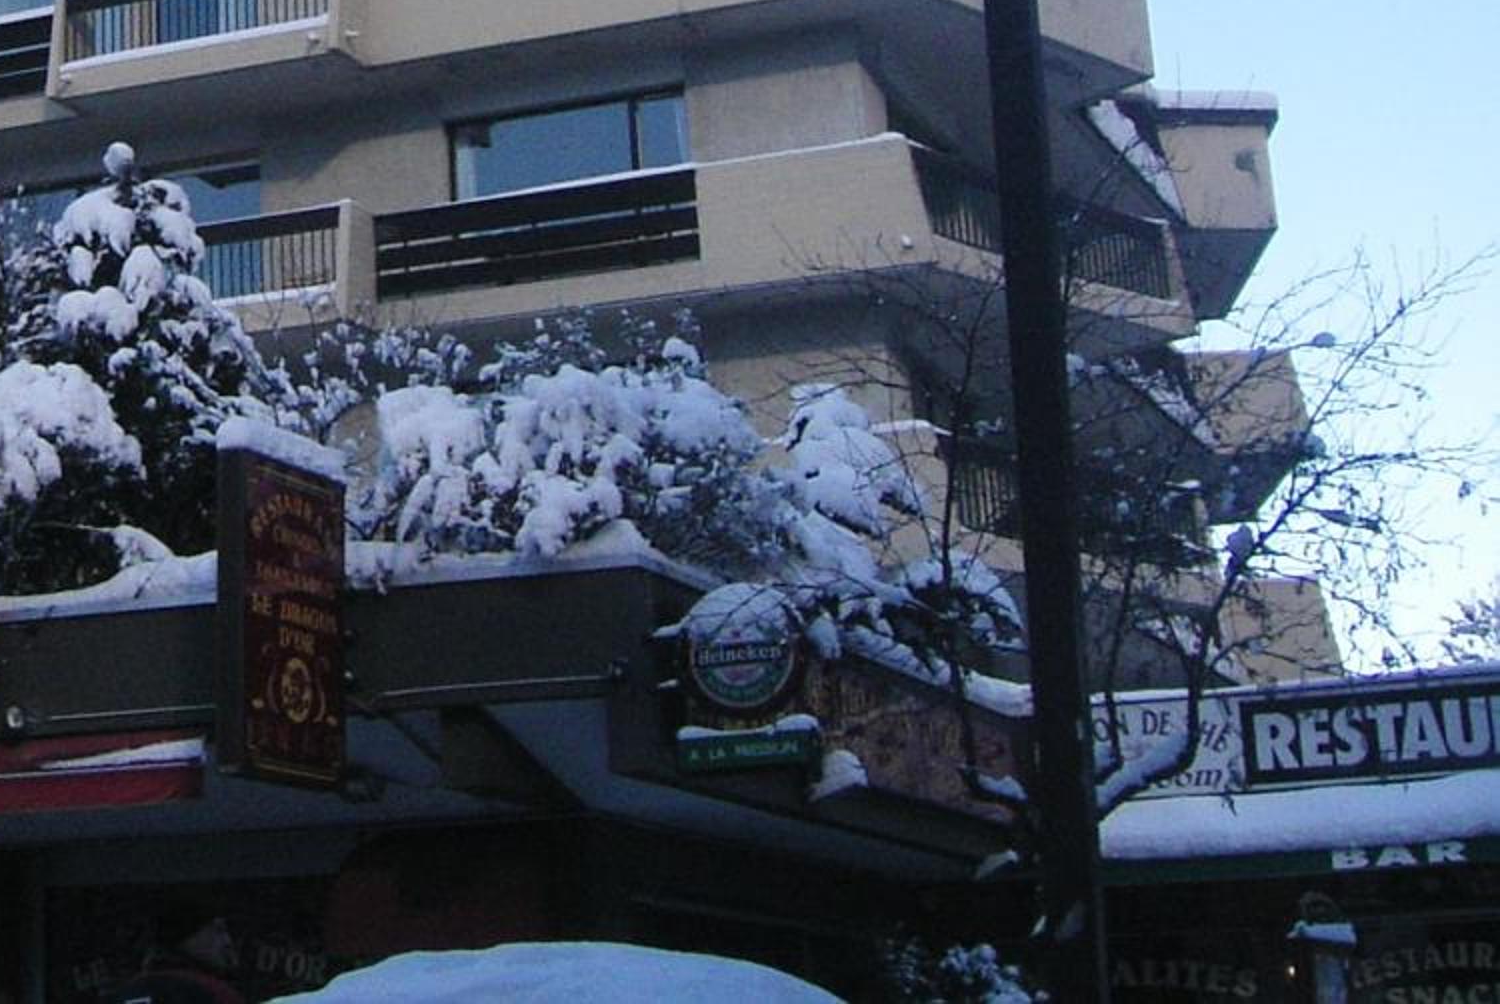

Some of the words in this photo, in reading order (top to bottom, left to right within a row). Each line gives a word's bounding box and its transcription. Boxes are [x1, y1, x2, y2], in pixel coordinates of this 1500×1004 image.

[698, 646, 782, 669] Heineken
[1142, 710, 1172, 737] DE
[1252, 693, 1500, 772] RESTAU
[1331, 839, 1469, 871] BAR
